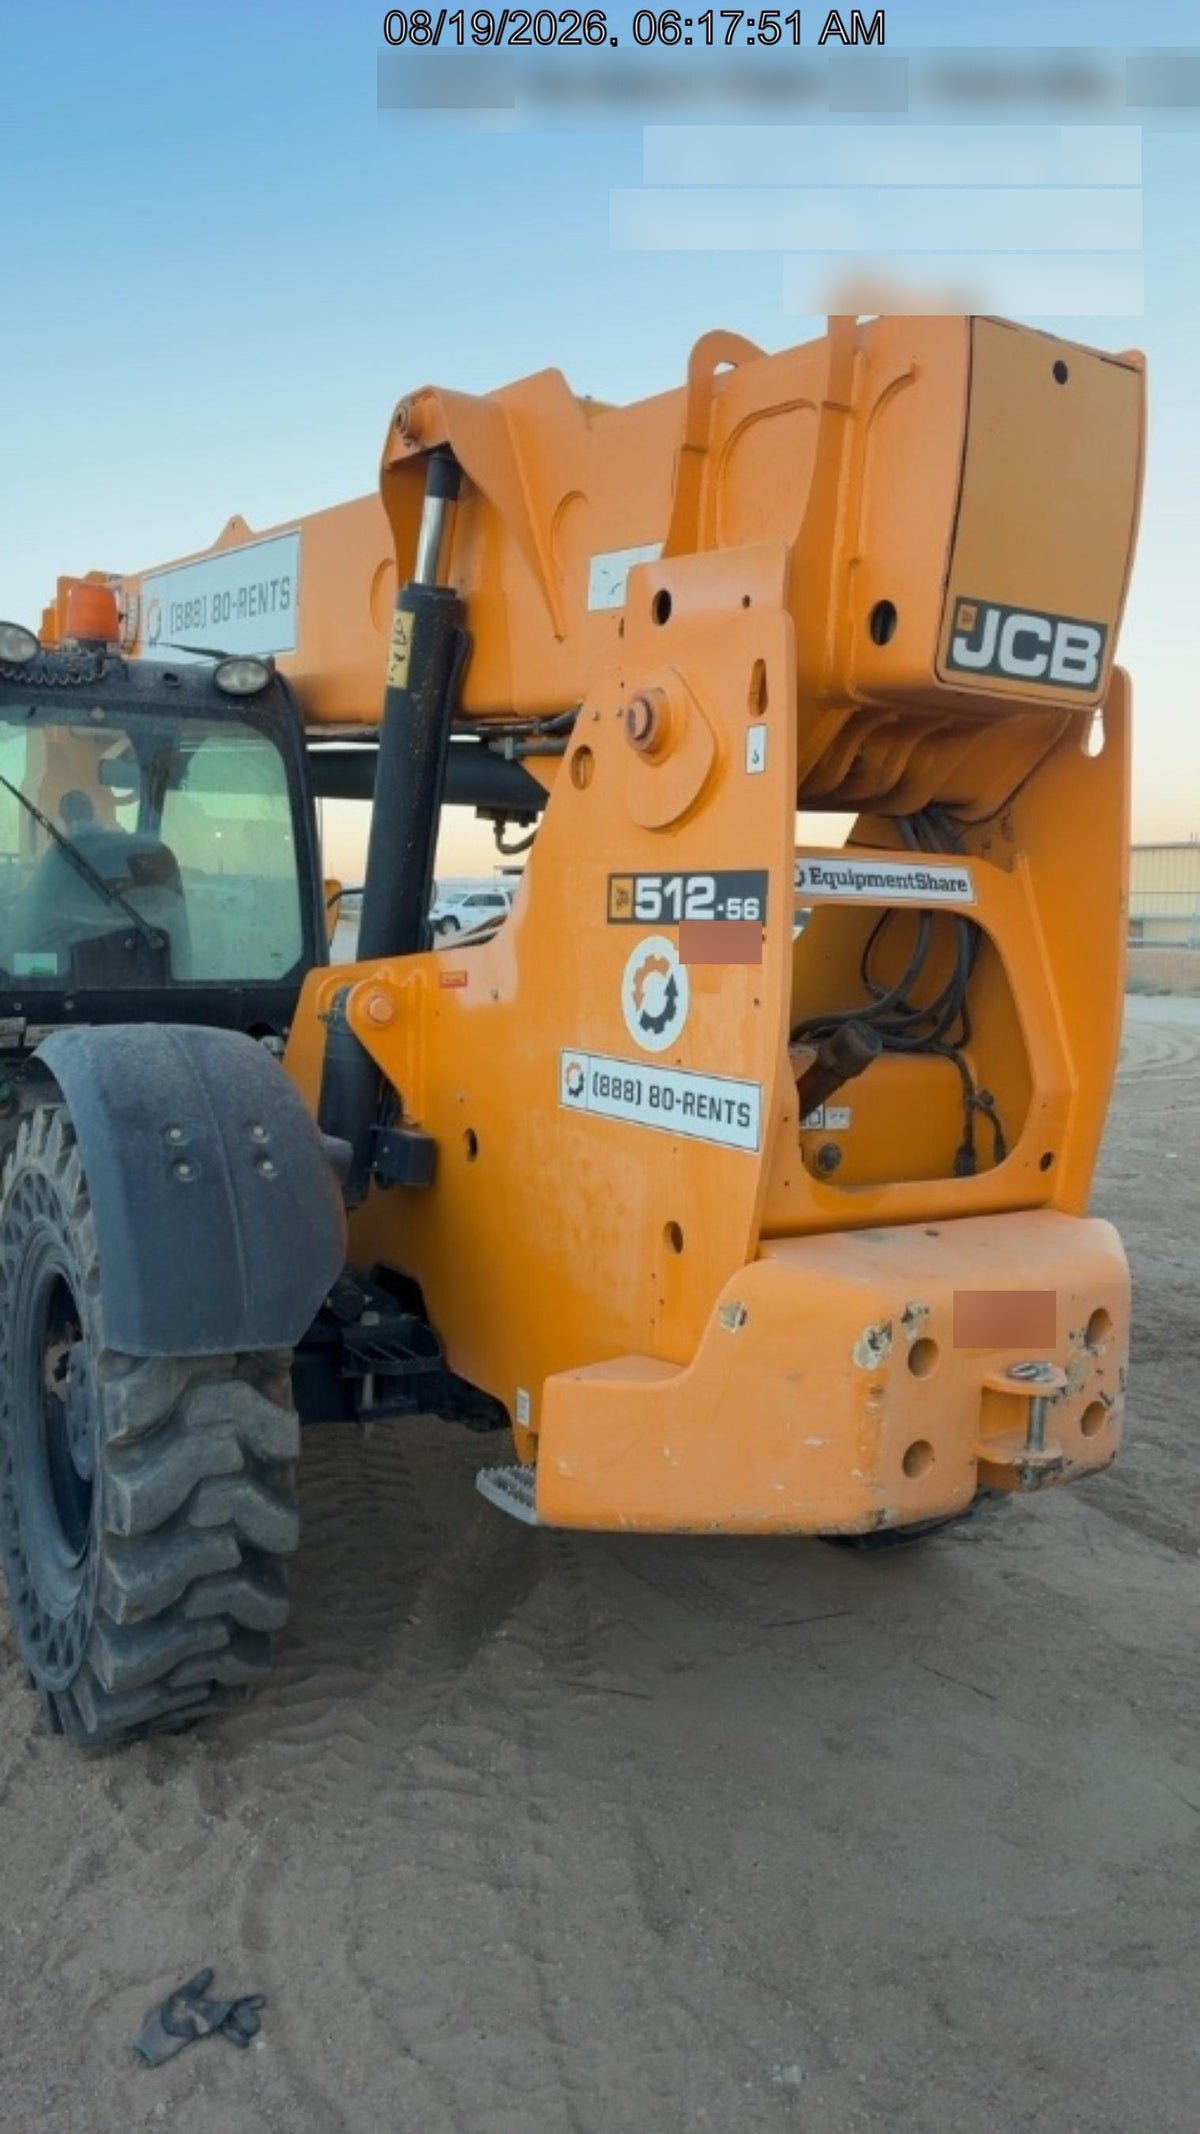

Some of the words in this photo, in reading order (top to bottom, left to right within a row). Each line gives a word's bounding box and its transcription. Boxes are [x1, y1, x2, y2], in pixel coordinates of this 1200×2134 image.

[211, 575, 291, 624] 80-RENTS
[952, 608, 1102, 684] JCB
[808, 866, 968, 892] EquipmentShare
[592, 1071, 642, 1106] (888)
[649, 1085, 751, 1128] 80-RENTS
